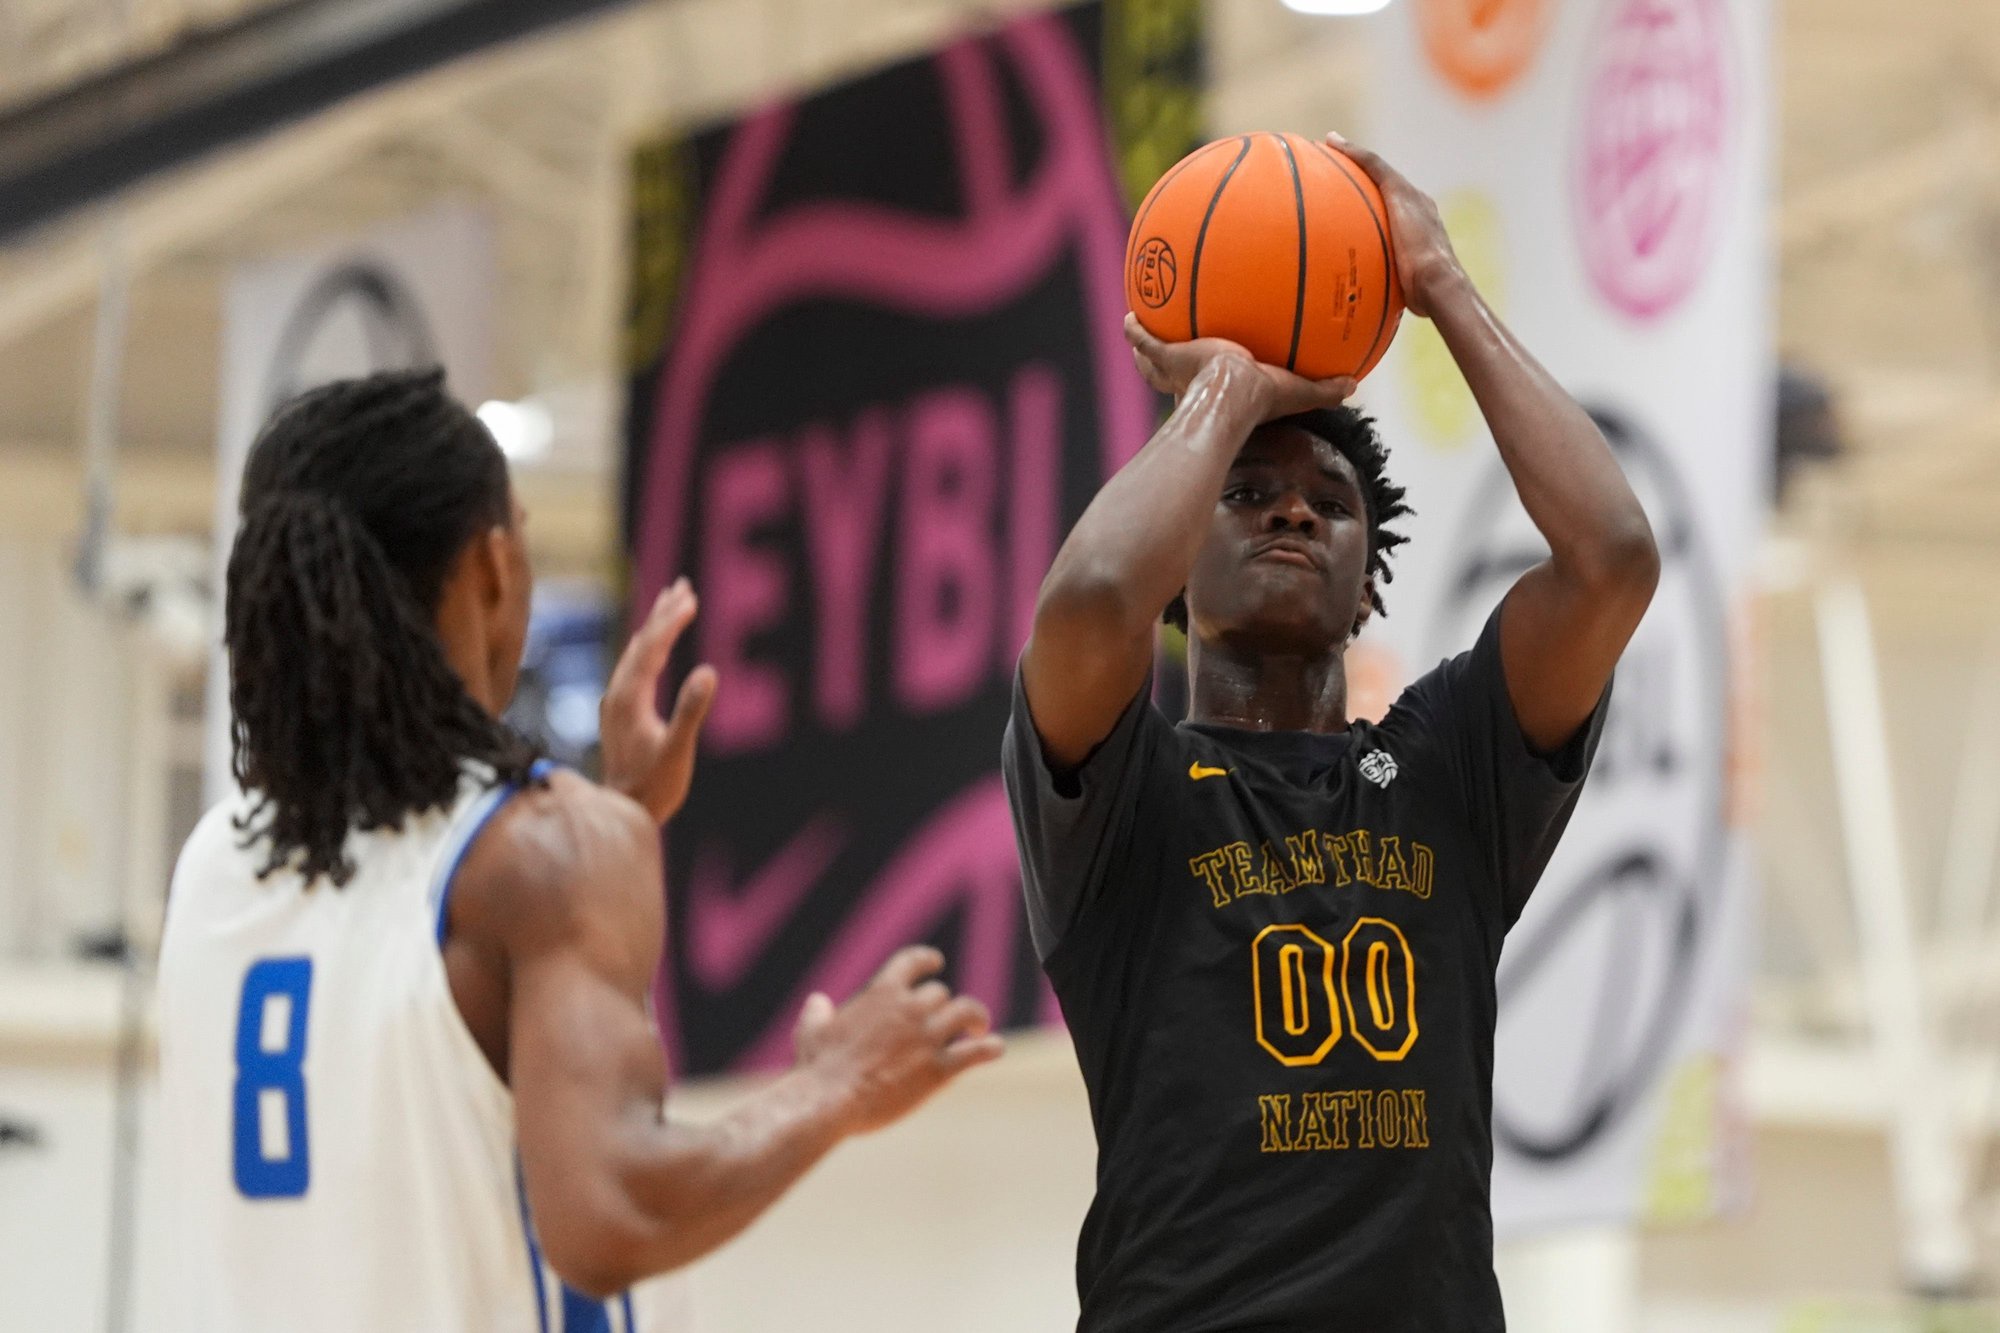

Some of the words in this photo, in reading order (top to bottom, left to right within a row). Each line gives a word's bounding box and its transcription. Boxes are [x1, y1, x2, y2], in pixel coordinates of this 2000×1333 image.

[1143, 245, 1159, 298] EYBL
[1252, 917, 1419, 1067] 00
[233, 956, 313, 1199] 8
[1258, 1089, 1430, 1153] NATION
